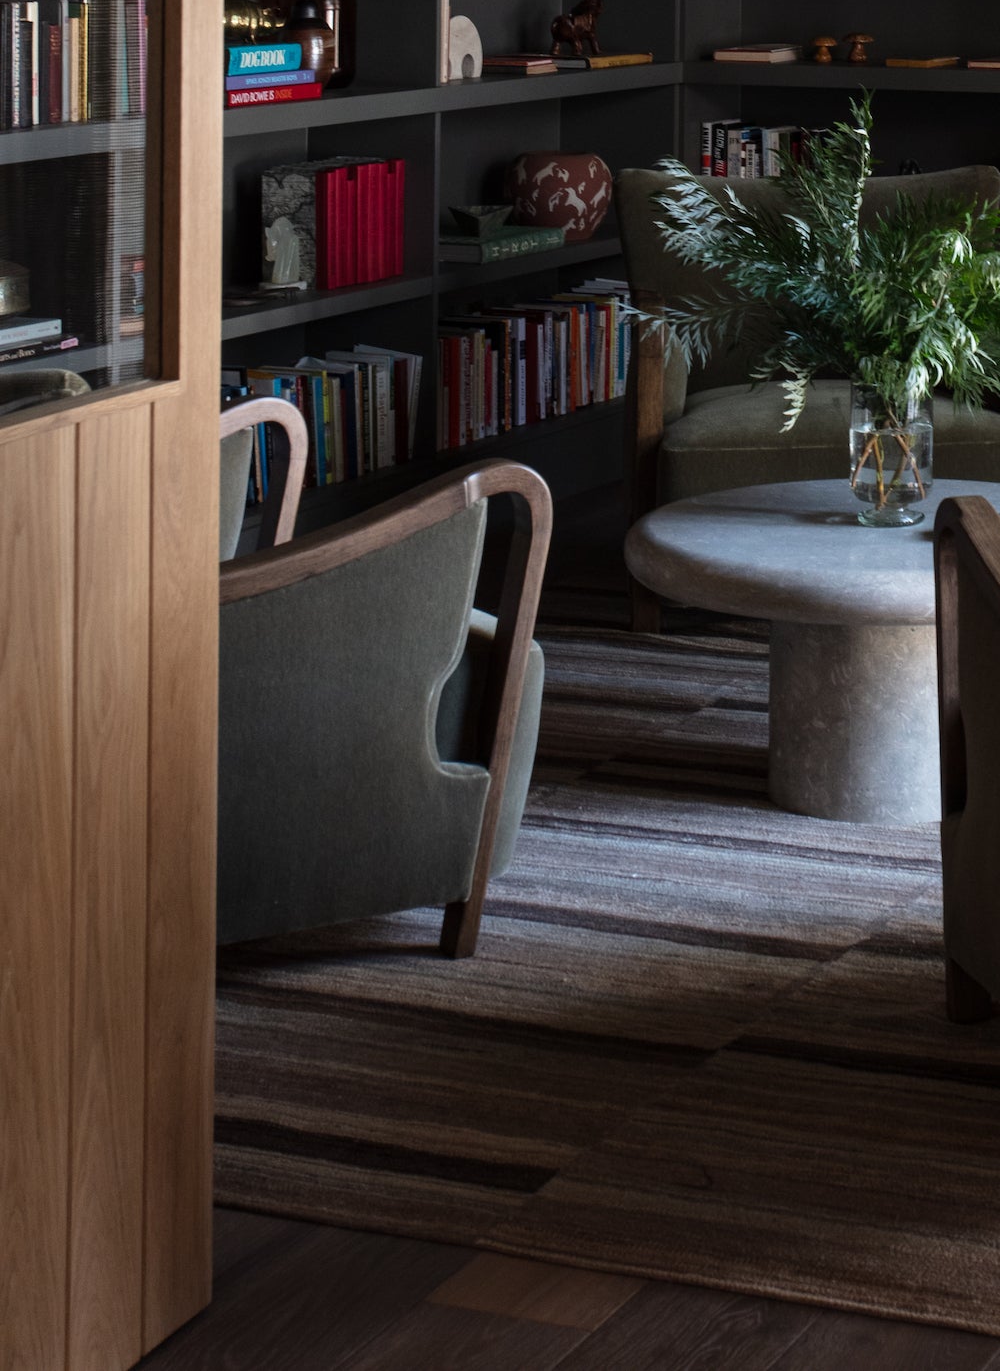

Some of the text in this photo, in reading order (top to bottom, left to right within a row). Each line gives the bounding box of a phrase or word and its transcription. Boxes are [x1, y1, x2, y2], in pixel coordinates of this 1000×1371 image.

[230, 92, 250, 104] DAVID
[250, 91, 268, 102] BOWIE
[716, 129, 725, 149] CATCH
[716, 159, 726, 174] KILL
